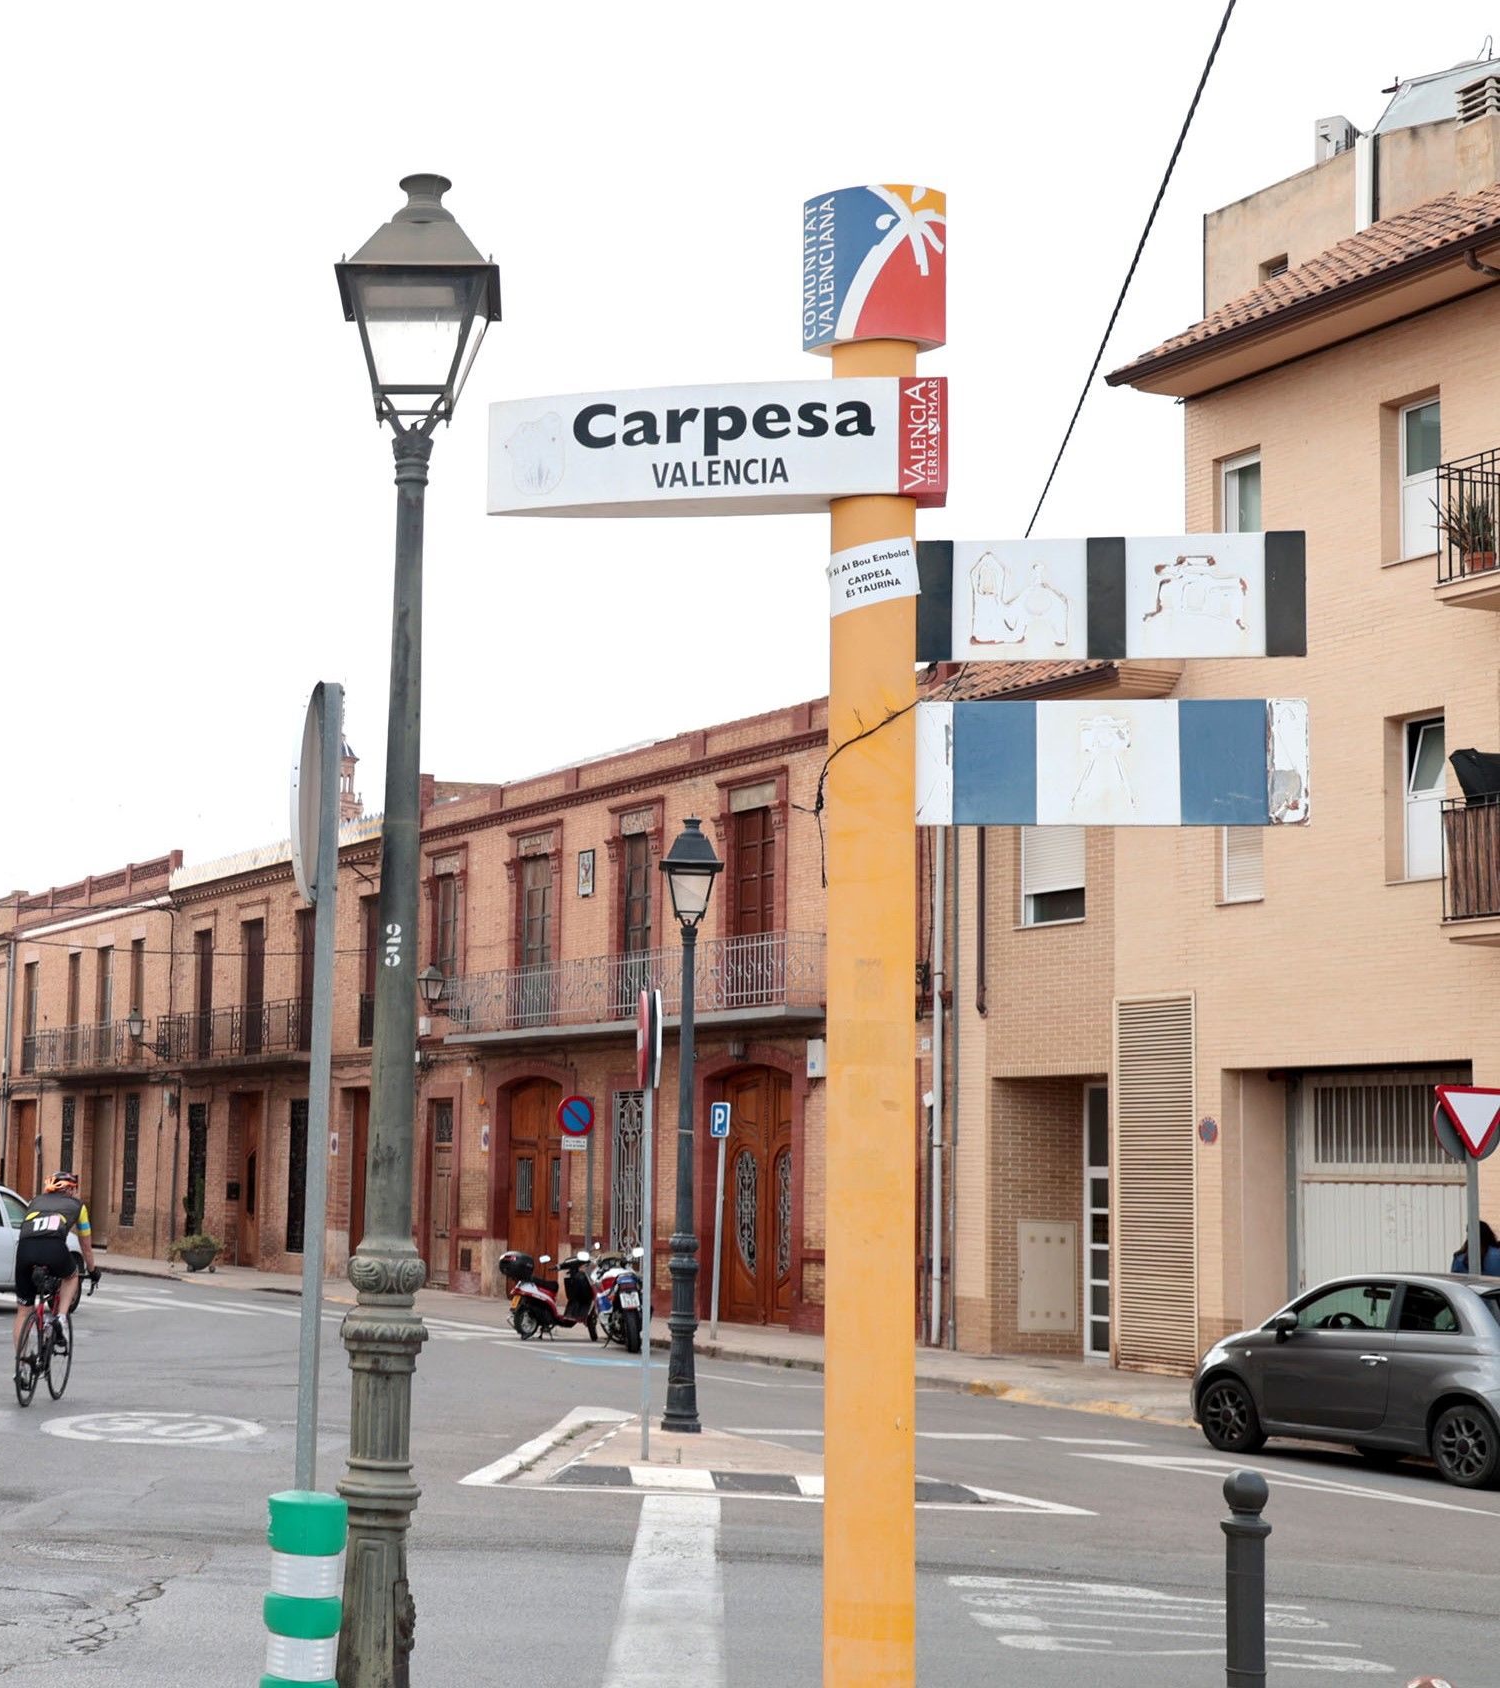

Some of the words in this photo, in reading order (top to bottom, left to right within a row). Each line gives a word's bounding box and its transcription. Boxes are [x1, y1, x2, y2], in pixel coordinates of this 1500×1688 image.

[803, 206, 817, 341] COMUNITAT
[819, 197, 835, 338] VALENCIANA
[927, 380, 938, 415] MAR
[572, 400, 876, 456] Carpesa
[652, 457, 789, 489] VALENCIA
[852, 559, 871, 569] Bou
[872, 549, 910, 562] Embolat
[848, 568, 892, 586] CARPESA
[856, 578, 902, 594] TAURINA
[714, 1107, 725, 1132] P
